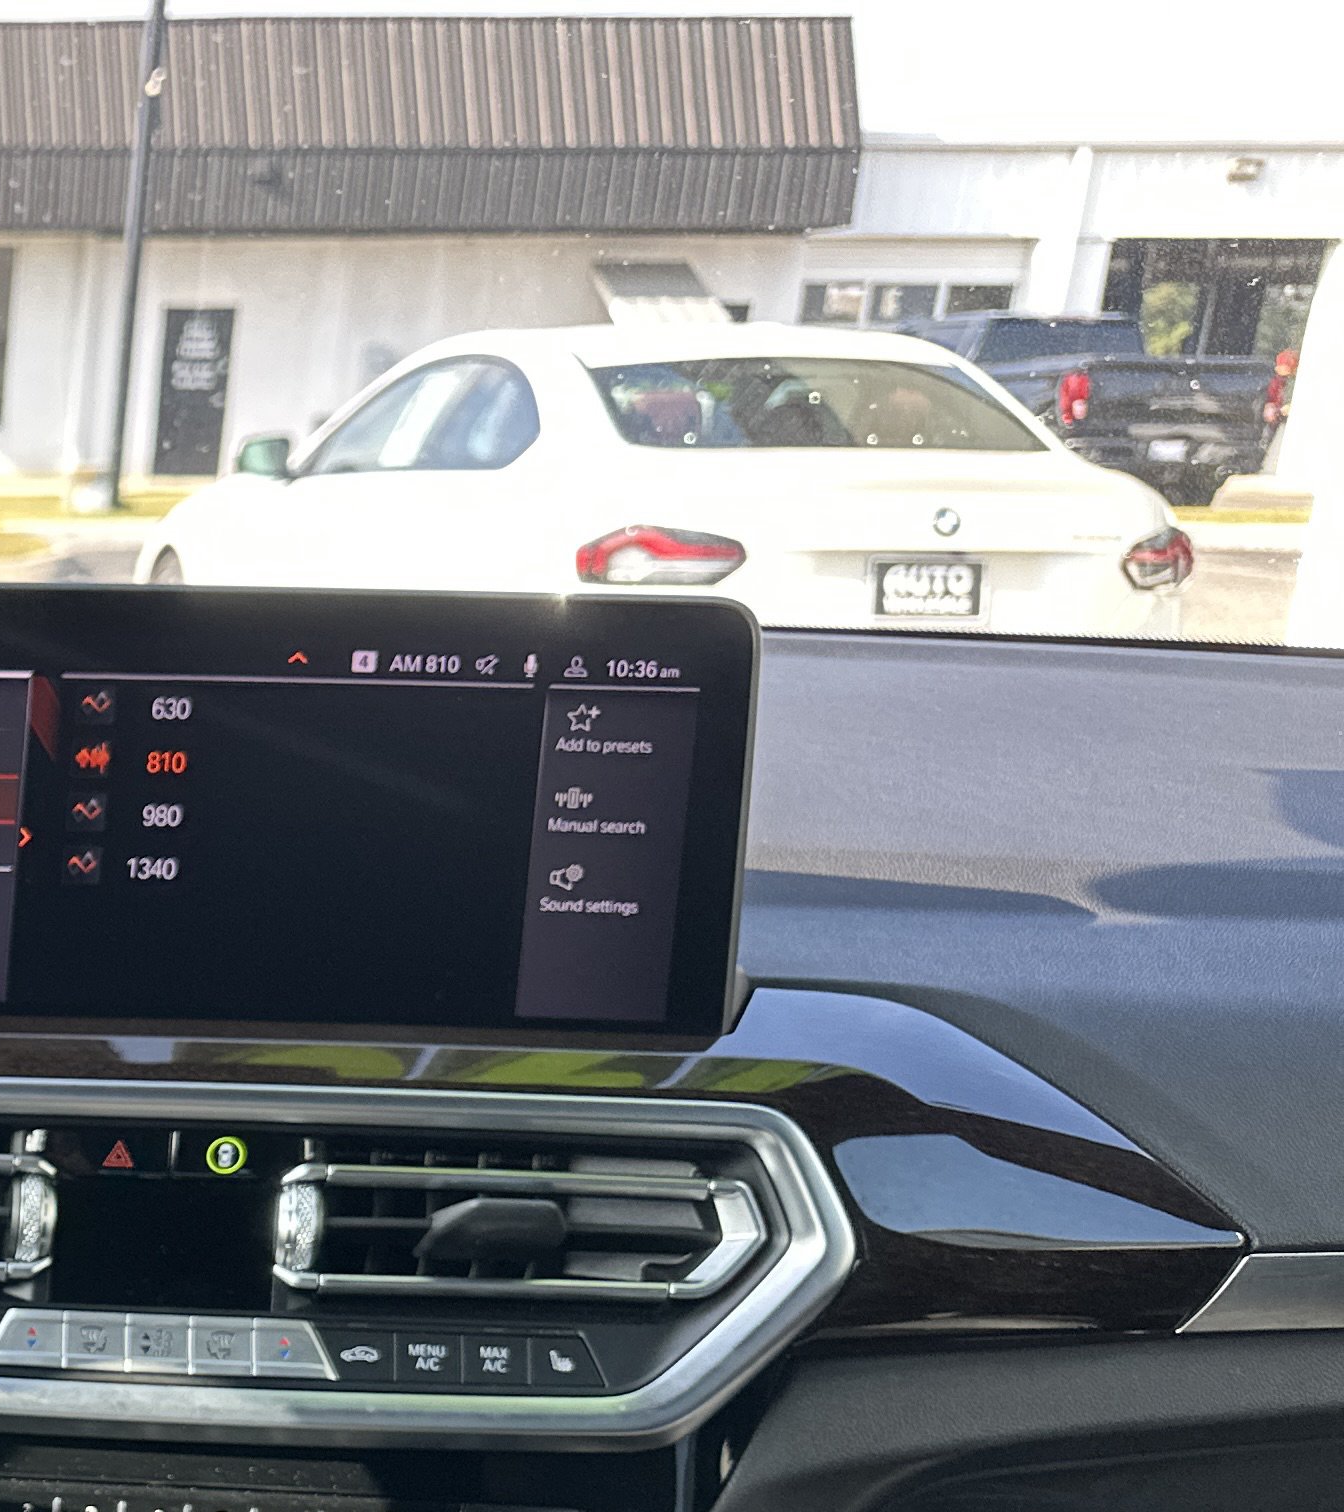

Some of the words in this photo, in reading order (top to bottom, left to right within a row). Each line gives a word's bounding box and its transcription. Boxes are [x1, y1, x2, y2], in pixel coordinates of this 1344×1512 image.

[389, 655, 424, 673] AM
[425, 655, 462, 674] 810
[605, 660, 658, 678] 10:36
[151, 697, 192, 720] 630
[555, 737, 585, 752] Add
[586, 738, 601, 752] to
[602, 740, 654, 755] presets
[146, 750, 187, 774] 810
[142, 803, 183, 827] 980
[547, 817, 599, 833] Manual
[600, 820, 647, 835] search
[127, 856, 180, 881] 1340
[539, 896, 584, 912] Sound
[585, 899, 640, 917] settings
[407, 1343, 448, 1358] MENU
[479, 1345, 509, 1359] MAX
[415, 1357, 442, 1373] A/C
[483, 1359, 509, 1374] A/C
